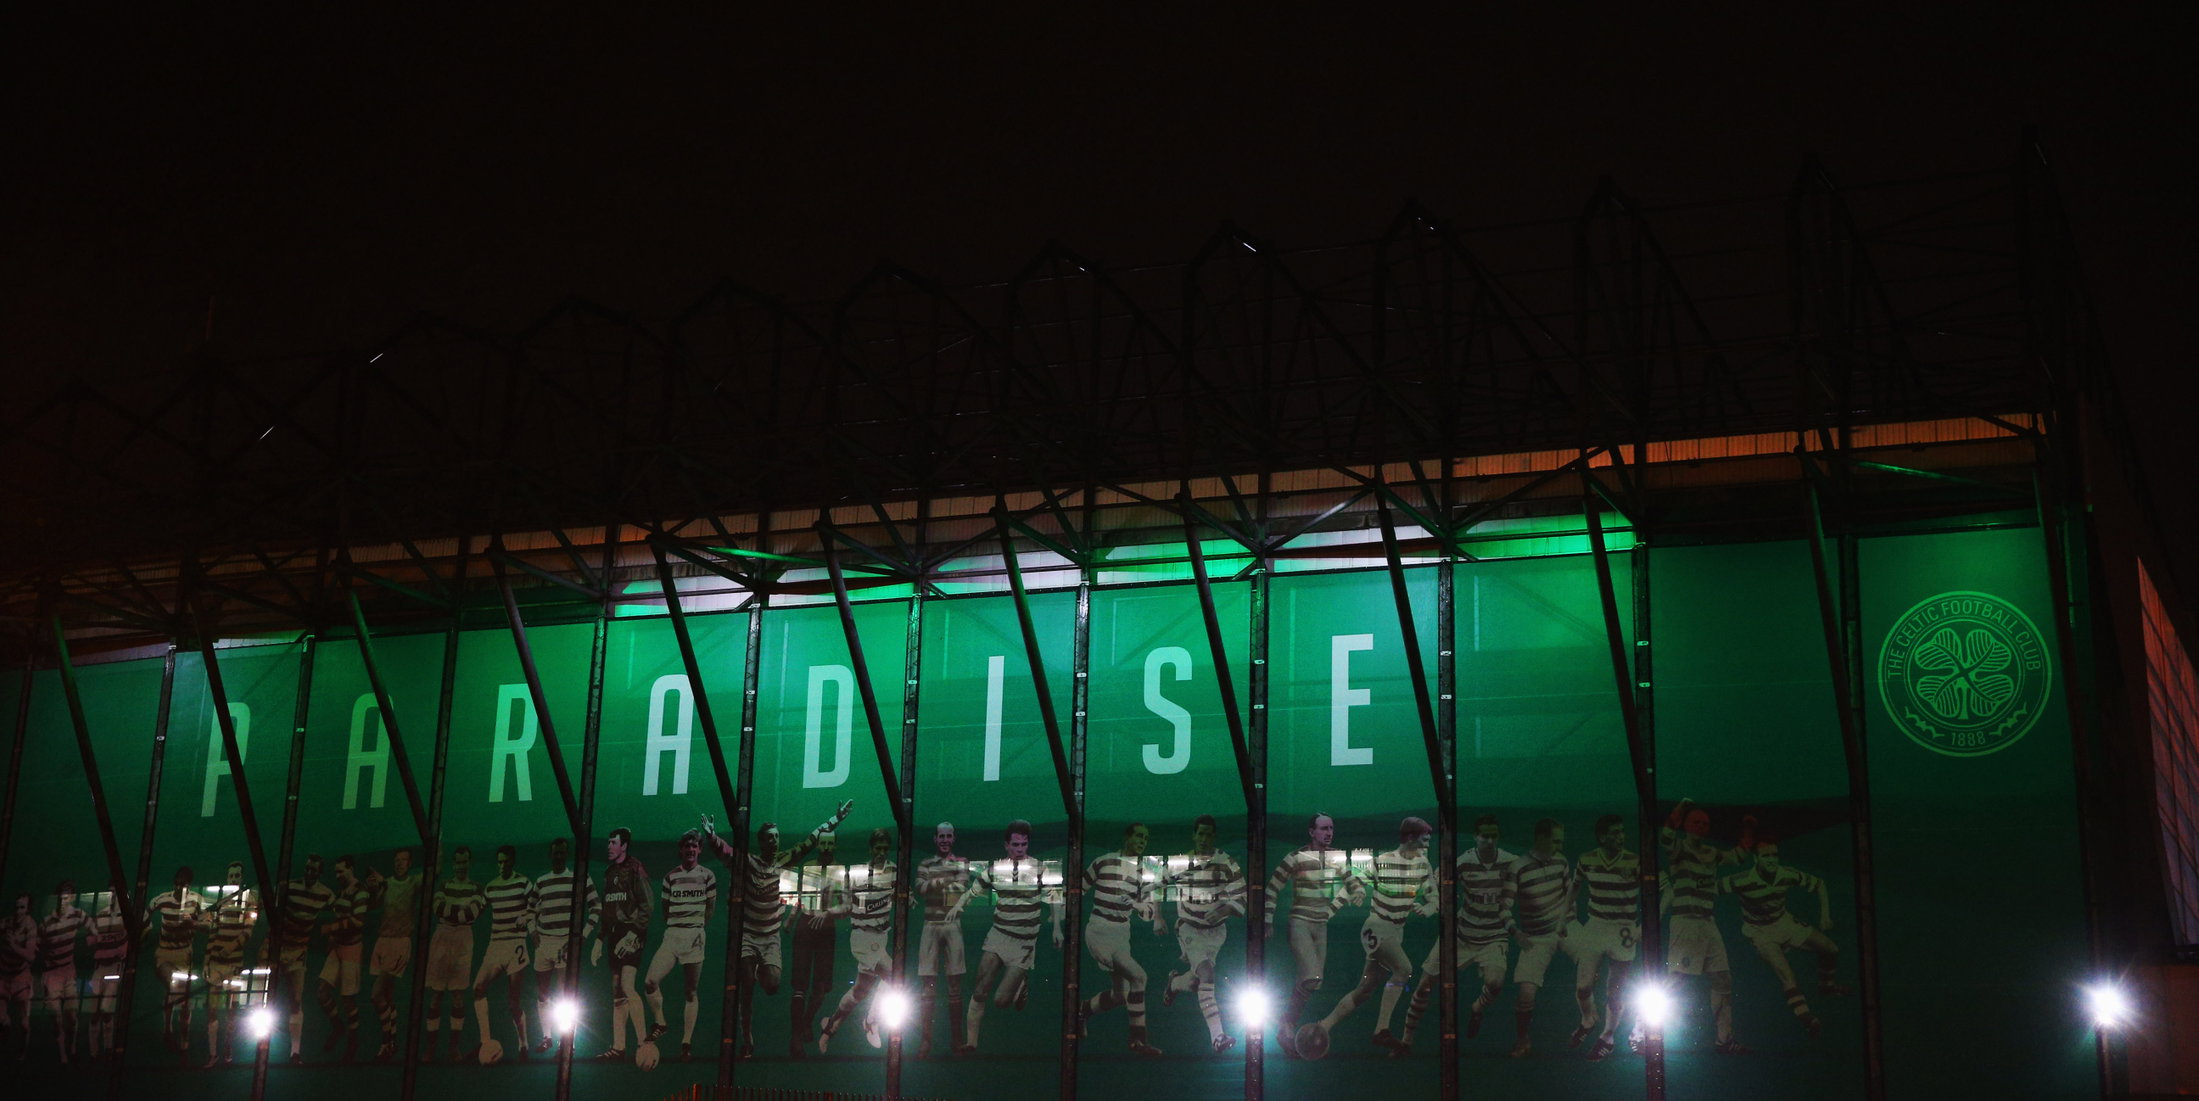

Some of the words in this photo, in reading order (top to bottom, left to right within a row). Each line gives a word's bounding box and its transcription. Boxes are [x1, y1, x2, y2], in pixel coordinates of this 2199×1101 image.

[1896, 606, 1939, 648] CELTIC
[1941, 600, 2019, 634] FOOTBALL
[2015, 631, 2042, 671] CLUB
[1887, 649, 1906, 679] THE
[200, 633, 1375, 818] PARADISE
[1951, 731, 1986, 747] 1888
[1363, 928, 1378, 949] 3
[1620, 927, 1633, 948] 8
[515, 945, 526, 965] 2
[1021, 946, 1034, 964] 7
